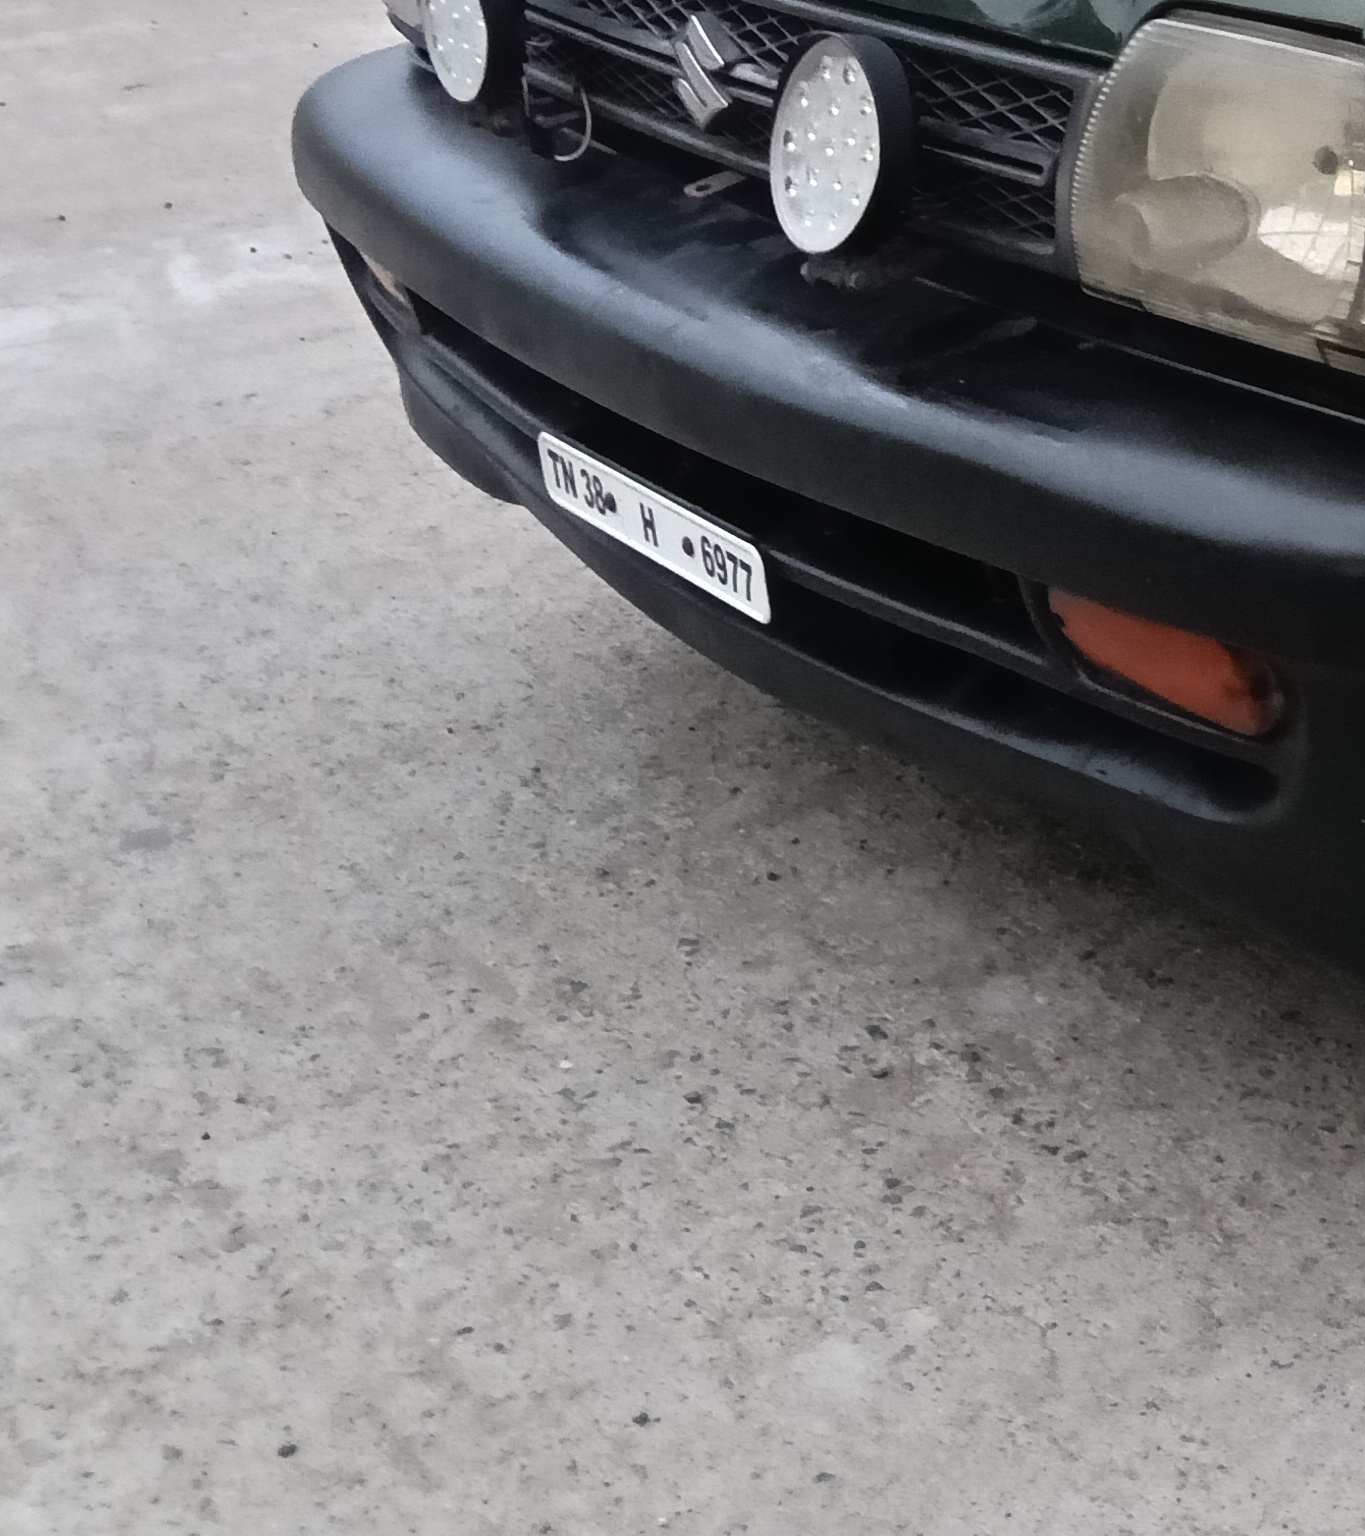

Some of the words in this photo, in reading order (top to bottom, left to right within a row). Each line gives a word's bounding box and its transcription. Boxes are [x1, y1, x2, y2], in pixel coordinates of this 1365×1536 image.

[547, 448, 578, 499] TN
[580, 468, 607, 516] 38
[639, 502, 659, 547] H
[700, 535, 752, 602] 6977
